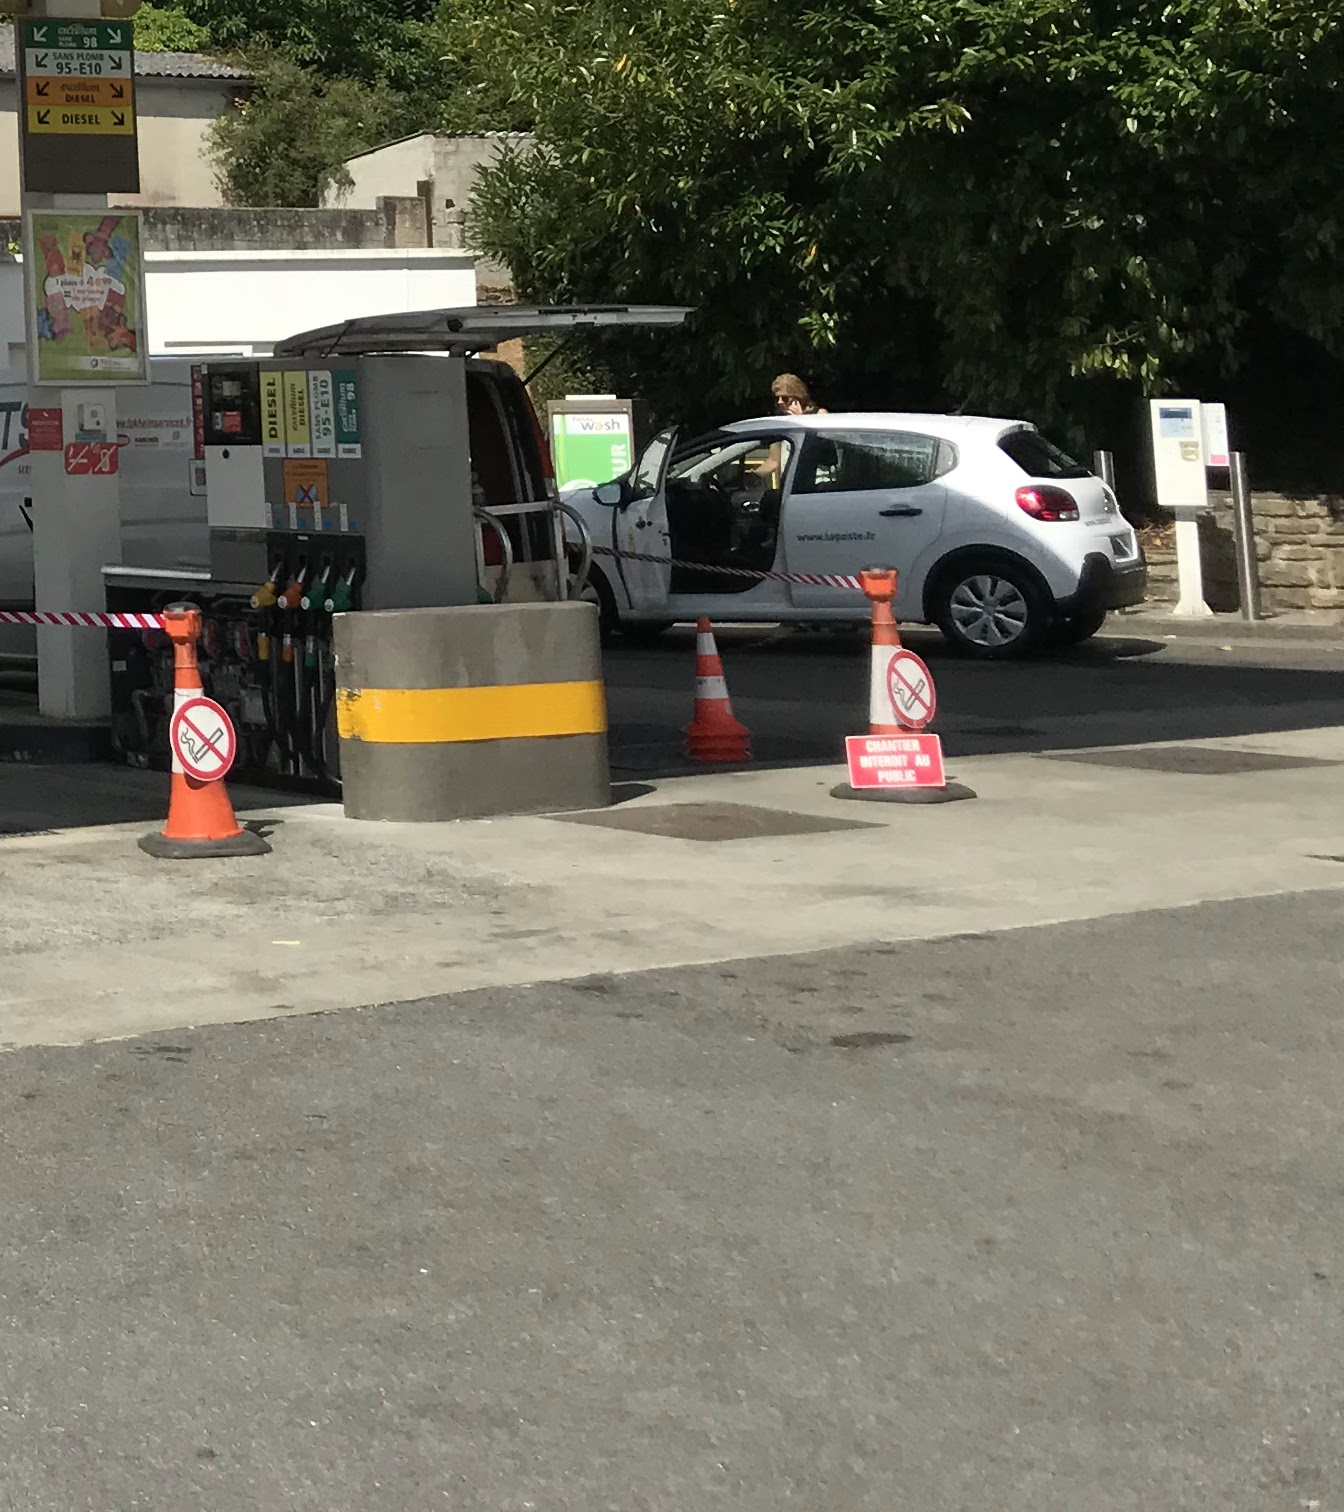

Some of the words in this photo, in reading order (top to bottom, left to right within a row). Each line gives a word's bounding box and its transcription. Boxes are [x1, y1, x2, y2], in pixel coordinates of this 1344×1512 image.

[83, 37, 98, 48] 98
[52, 52, 74, 61] SANS
[77, 53, 104, 61] PLOMB
[56, 62, 102, 75] 95-E10
[65, 94, 96, 103] DIESEL
[62, 114, 101, 125] DIESEL
[347, 383, 355, 400] 98
[267, 377, 278, 439] DIESEL
[320, 379, 331, 437] 95-E10
[580, 418, 620, 430] wash
[865, 739, 920, 752] CHANTIER
[859, 755, 908, 768] INTERDIT
[915, 754, 930, 766] AU
[877, 770, 917, 782] PUBLIC
